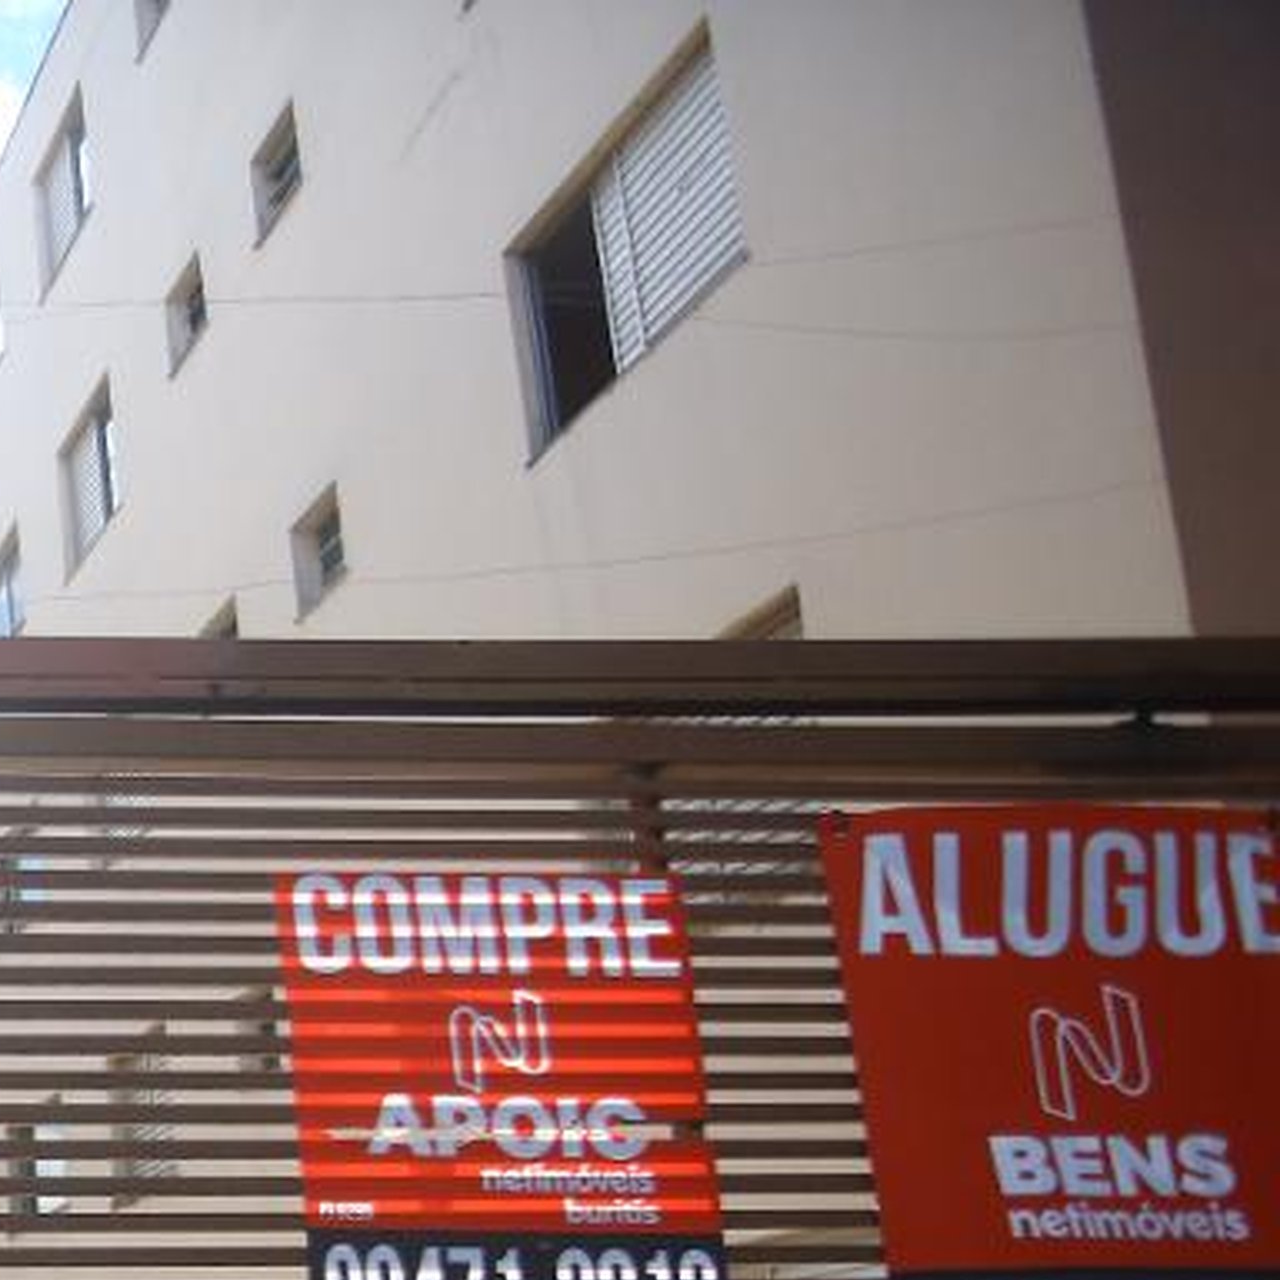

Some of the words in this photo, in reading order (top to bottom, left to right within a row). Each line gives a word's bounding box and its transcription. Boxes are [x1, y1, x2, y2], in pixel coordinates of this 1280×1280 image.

[292, 873, 682, 978] COMPRE
[858, 828, 1280, 959] ALUGUE
[987, 1134, 1237, 1198] BENS
[1009, 1200, 1251, 1242] netimóveis
